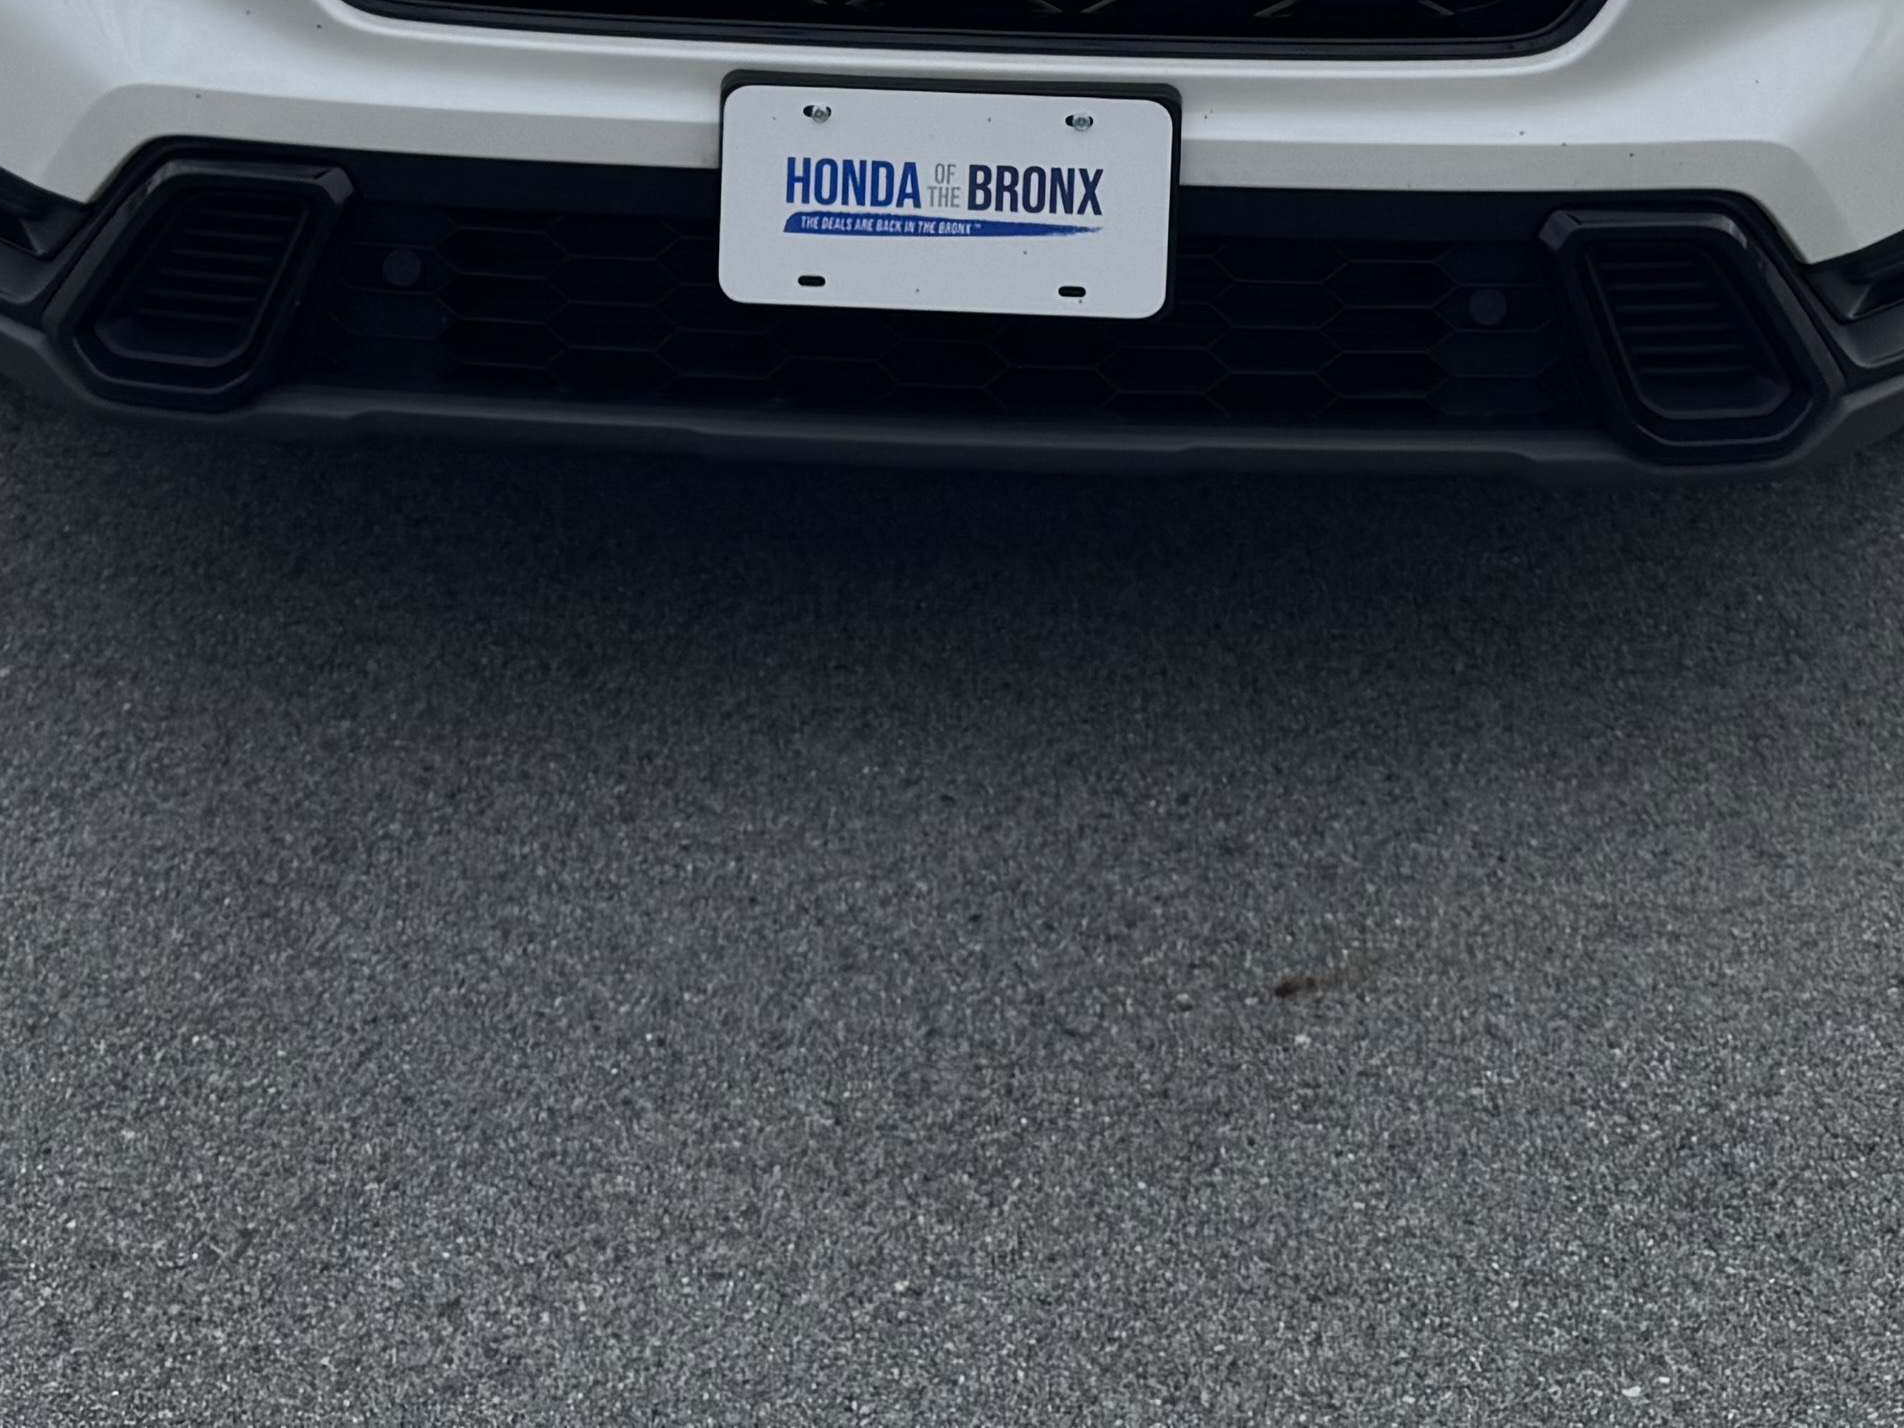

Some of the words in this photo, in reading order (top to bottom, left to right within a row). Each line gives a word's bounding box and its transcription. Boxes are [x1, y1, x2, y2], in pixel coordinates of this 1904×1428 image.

[786, 156, 921, 208] HONDA
[934, 162, 957, 185] OF
[927, 185, 961, 208] THE
[967, 164, 1104, 216] BRONX
[801, 215, 819, 230] THE
[821, 216, 853, 231] DEALS
[854, 217, 874, 232] ARE
[875, 219, 902, 233] BACK
[904, 220, 916, 233] IN
[917, 221, 936, 235] THE
